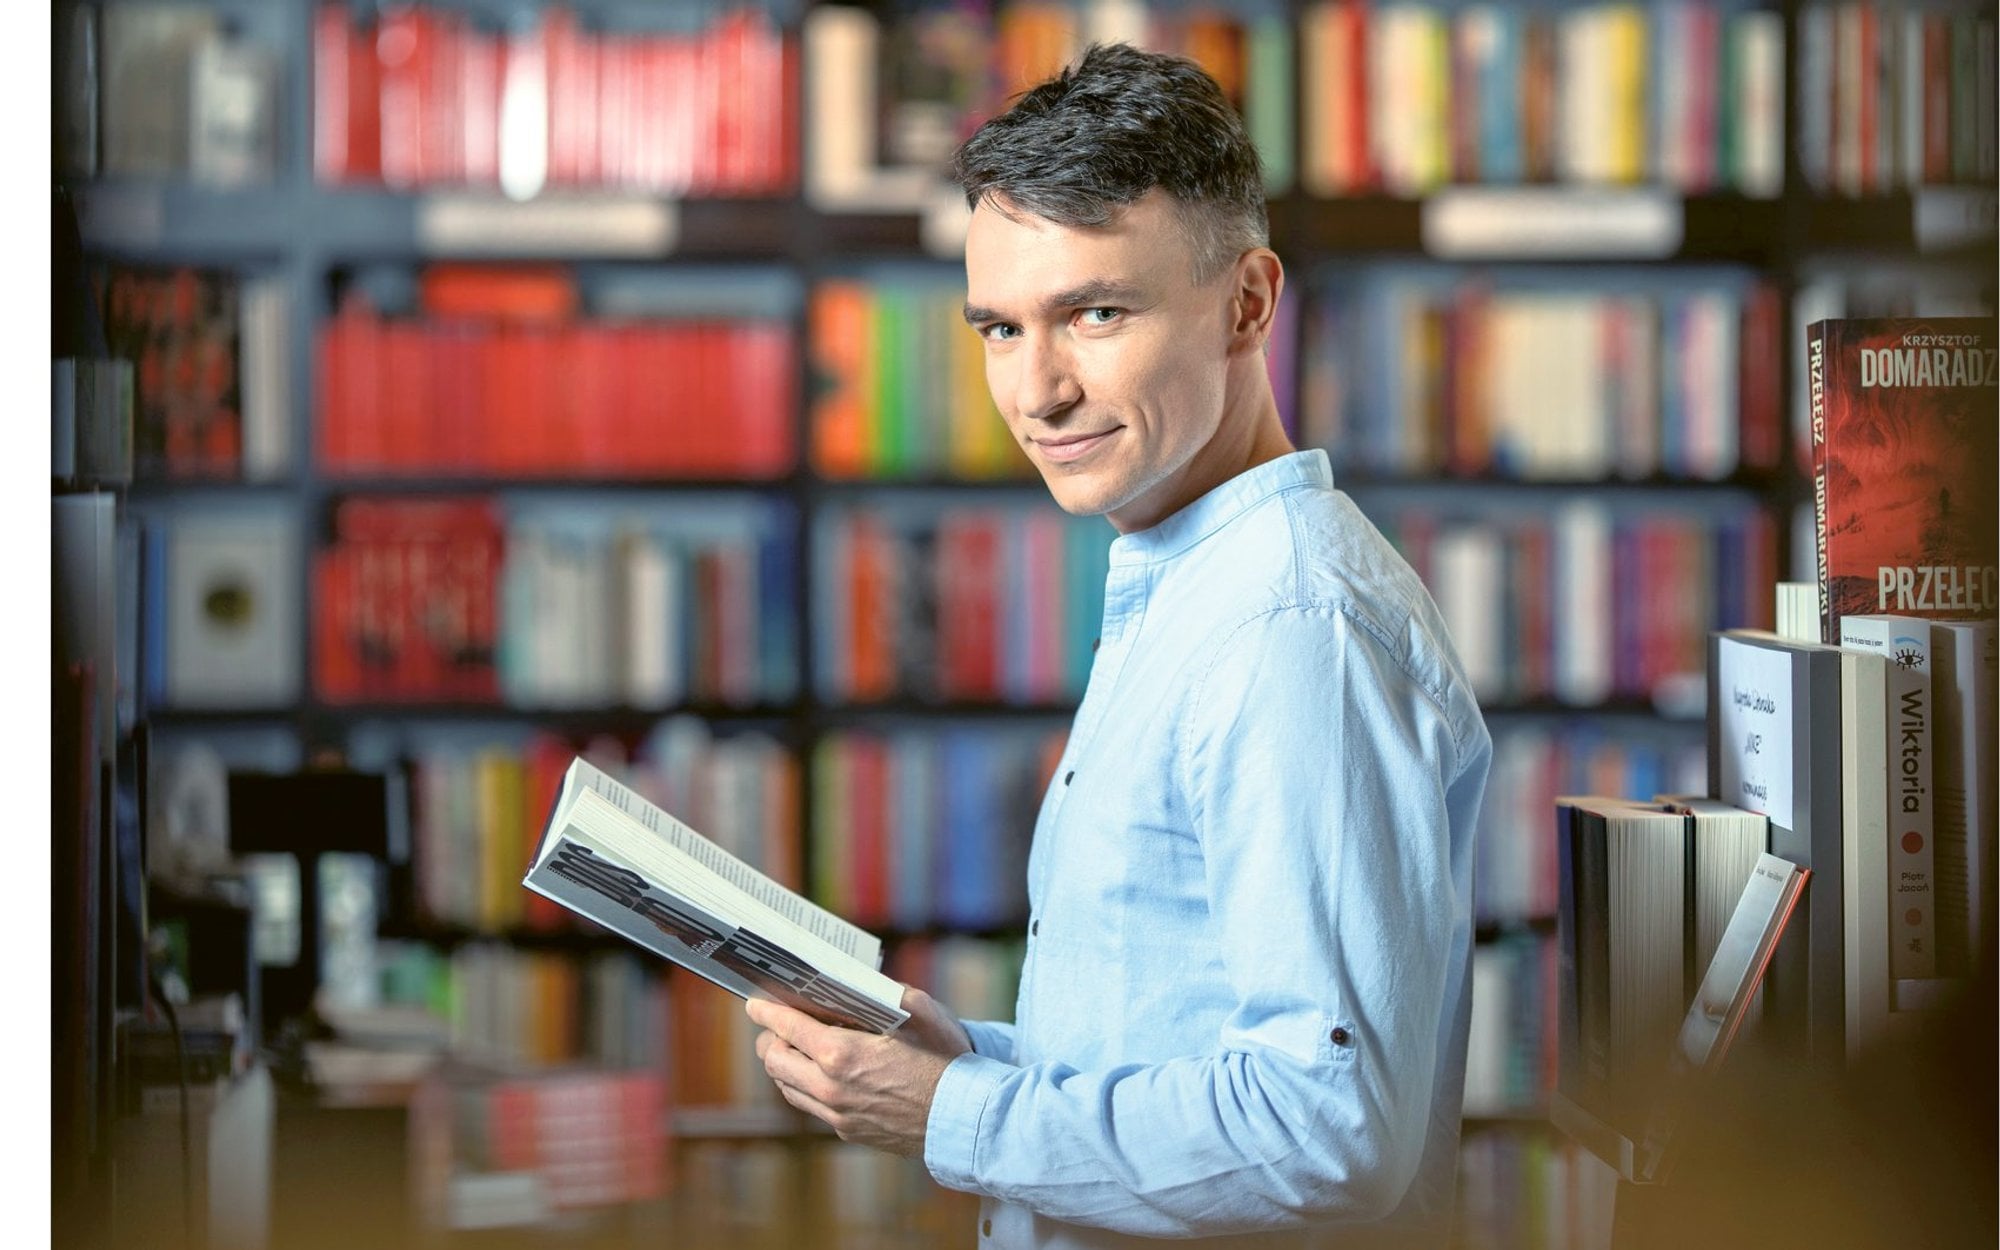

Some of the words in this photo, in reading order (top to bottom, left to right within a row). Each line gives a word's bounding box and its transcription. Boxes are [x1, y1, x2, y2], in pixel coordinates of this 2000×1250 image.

[1903, 335, 1980, 346] KRZYSZTOF
[1815, 475, 1828, 615] DOMARADZKI
[1901, 689, 1925, 813] Wiktoria
[1901, 872, 1925, 881] Piotr
[1897, 883, 1929, 892] Jacoń
